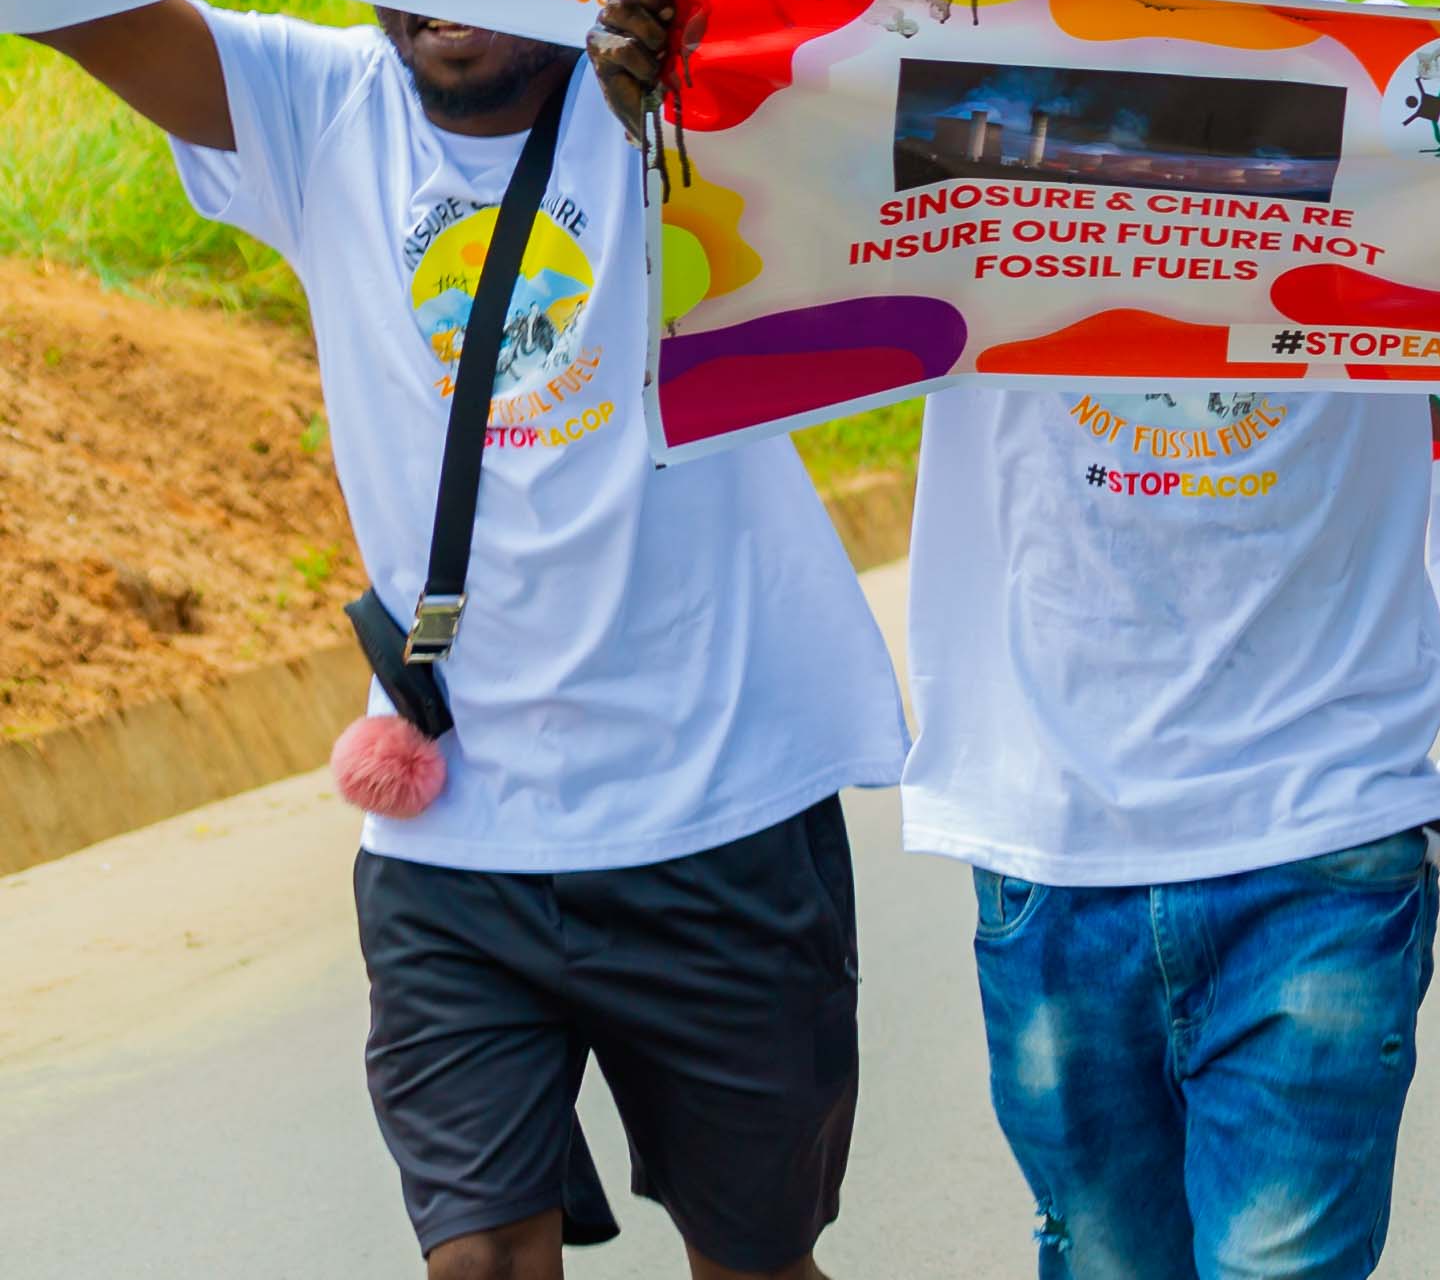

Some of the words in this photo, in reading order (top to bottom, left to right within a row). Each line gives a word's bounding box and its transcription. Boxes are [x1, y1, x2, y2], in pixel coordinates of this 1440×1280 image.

[879, 184, 1096, 226] SINOSURE
[1105, 192, 1135, 212] &
[1146, 195, 1293, 224] CHINA
[1301, 206, 1355, 229] RE
[849, 220, 1001, 266] INSURE
[1012, 219, 1106, 246] OUR
[1116, 223, 1281, 252] FUTURE
[1291, 234, 1385, 267] NOT
[974, 254, 1121, 280] FOSSIL
[1131, 257, 1259, 282] FUELS
[1070, 394, 1128, 444] NOT
[1133, 425, 1217, 459] FOSSIL
[1217, 399, 1288, 456] FUELS
[1085, 463, 1279, 499] #STOPEACOP
